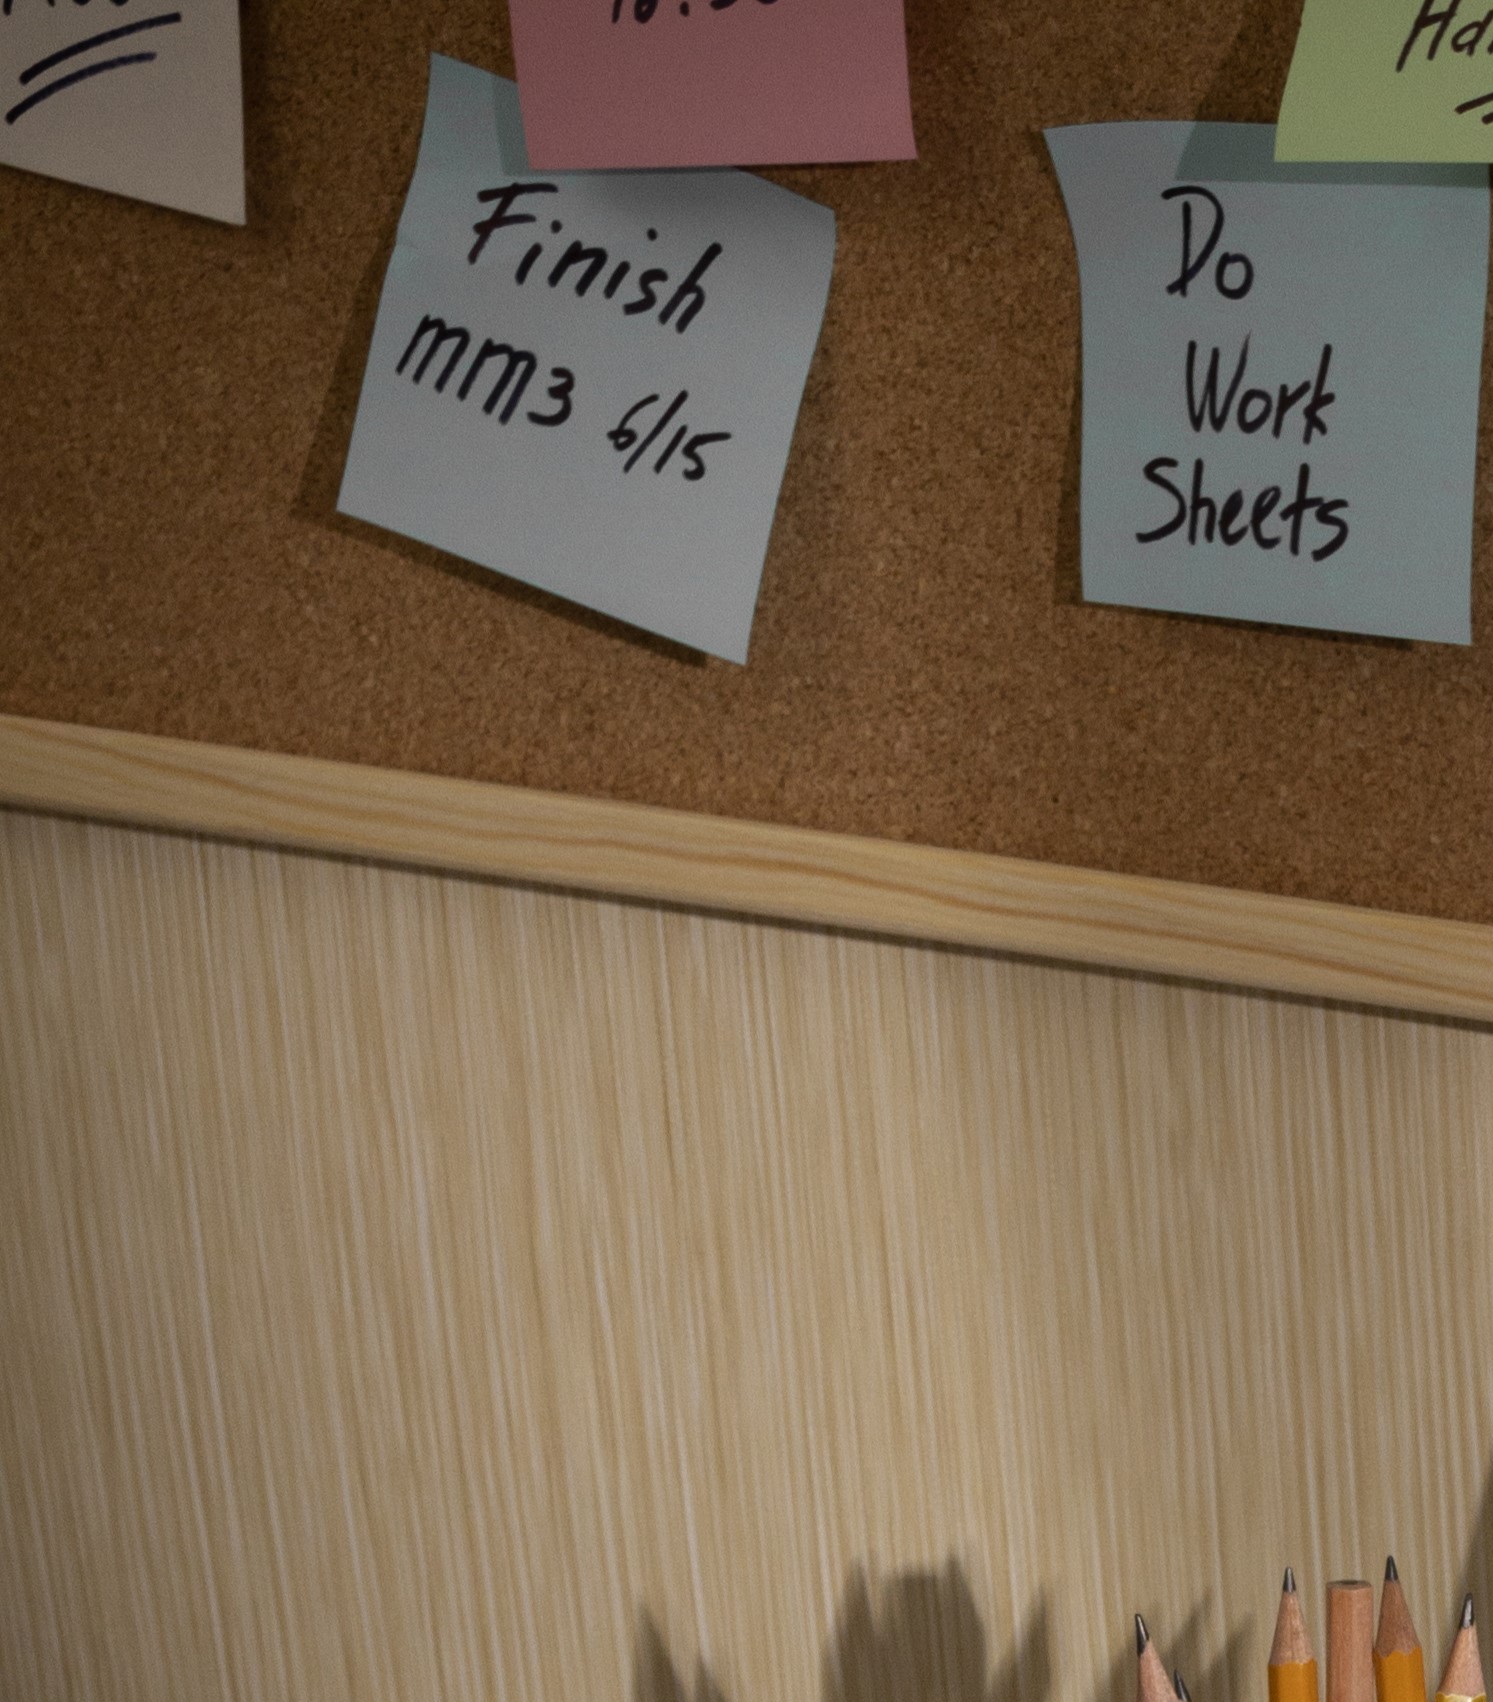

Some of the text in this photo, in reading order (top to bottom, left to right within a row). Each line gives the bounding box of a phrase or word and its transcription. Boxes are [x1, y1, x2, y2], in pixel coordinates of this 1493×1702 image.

[468, 183, 722, 333] Finish
[1161, 185, 1254, 299] Do
[607, 390, 731, 481] 6/15
[1186, 333, 1335, 444] Work
[1136, 457, 1348, 561] Sheets
